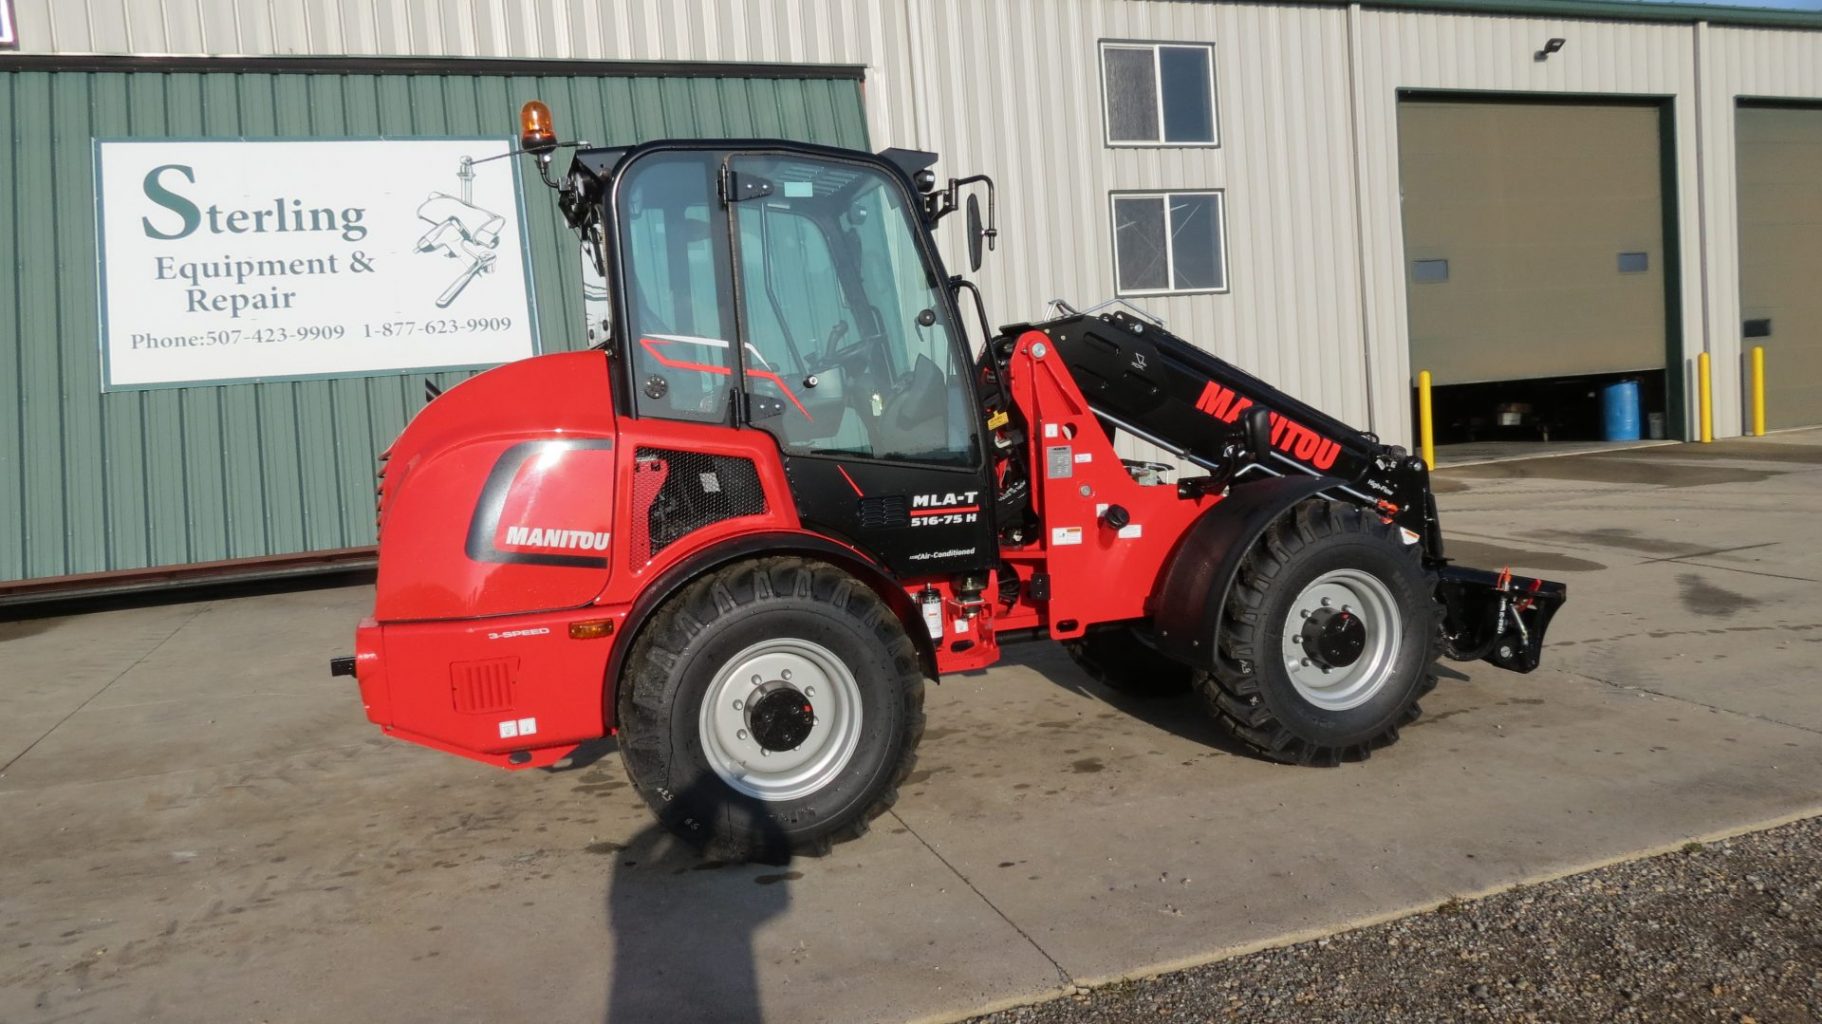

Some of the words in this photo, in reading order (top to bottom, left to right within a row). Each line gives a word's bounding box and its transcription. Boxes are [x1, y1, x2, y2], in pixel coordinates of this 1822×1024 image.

[141, 163, 368, 242] Sterling
[155, 253, 339, 285] Equipment
[349, 250, 376, 273] &
[186, 285, 297, 318] Repair
[130, 324, 346, 350] Phone:507-423-9909
[362, 316, 512, 339] 1-877-623-9909
[1195, 380, 1342, 470] MAITOU
[913, 492, 978, 507] MLA-T
[911, 514, 962, 527] 516-75
[966, 513, 977, 522] H
[506, 526, 609, 550] MANITOU
[488, 627, 550, 639] 3-SPEED
